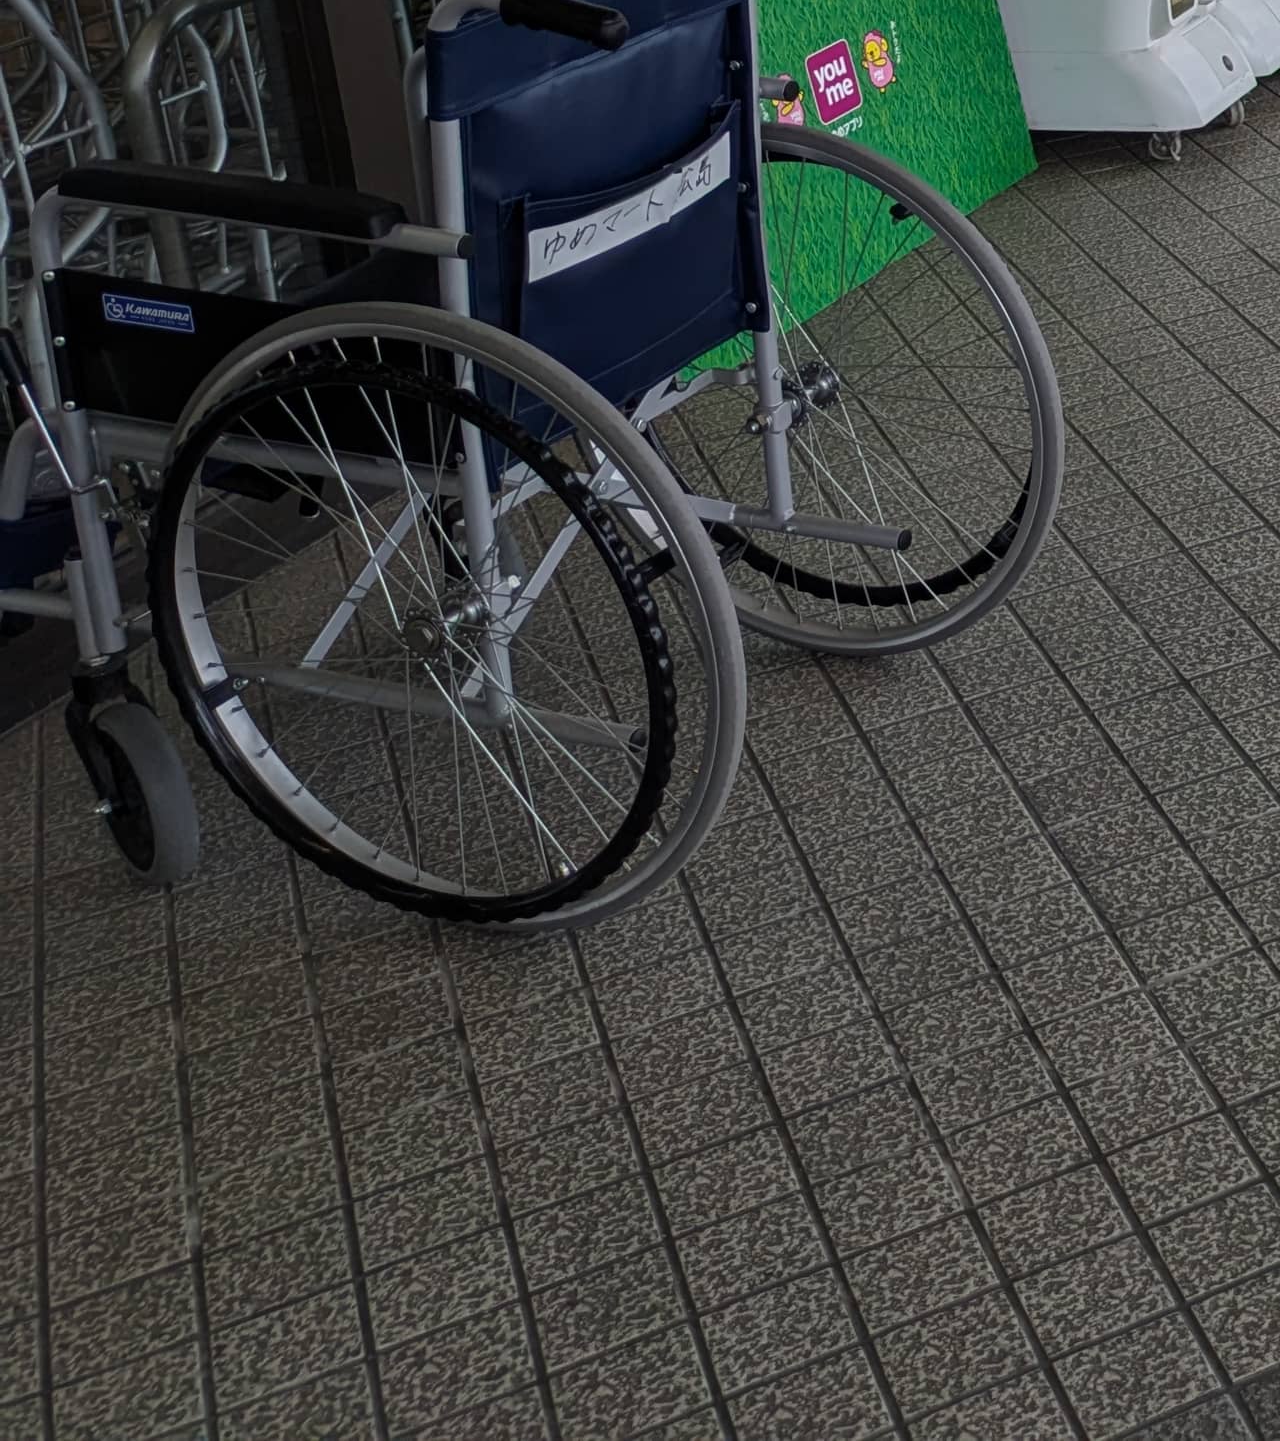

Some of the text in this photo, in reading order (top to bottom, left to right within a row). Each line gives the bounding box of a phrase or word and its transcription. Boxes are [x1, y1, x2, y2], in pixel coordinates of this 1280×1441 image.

[814, 56, 847, 93] you
[826, 77, 854, 106] me
[125, 303, 190, 322] KAWAMURA
